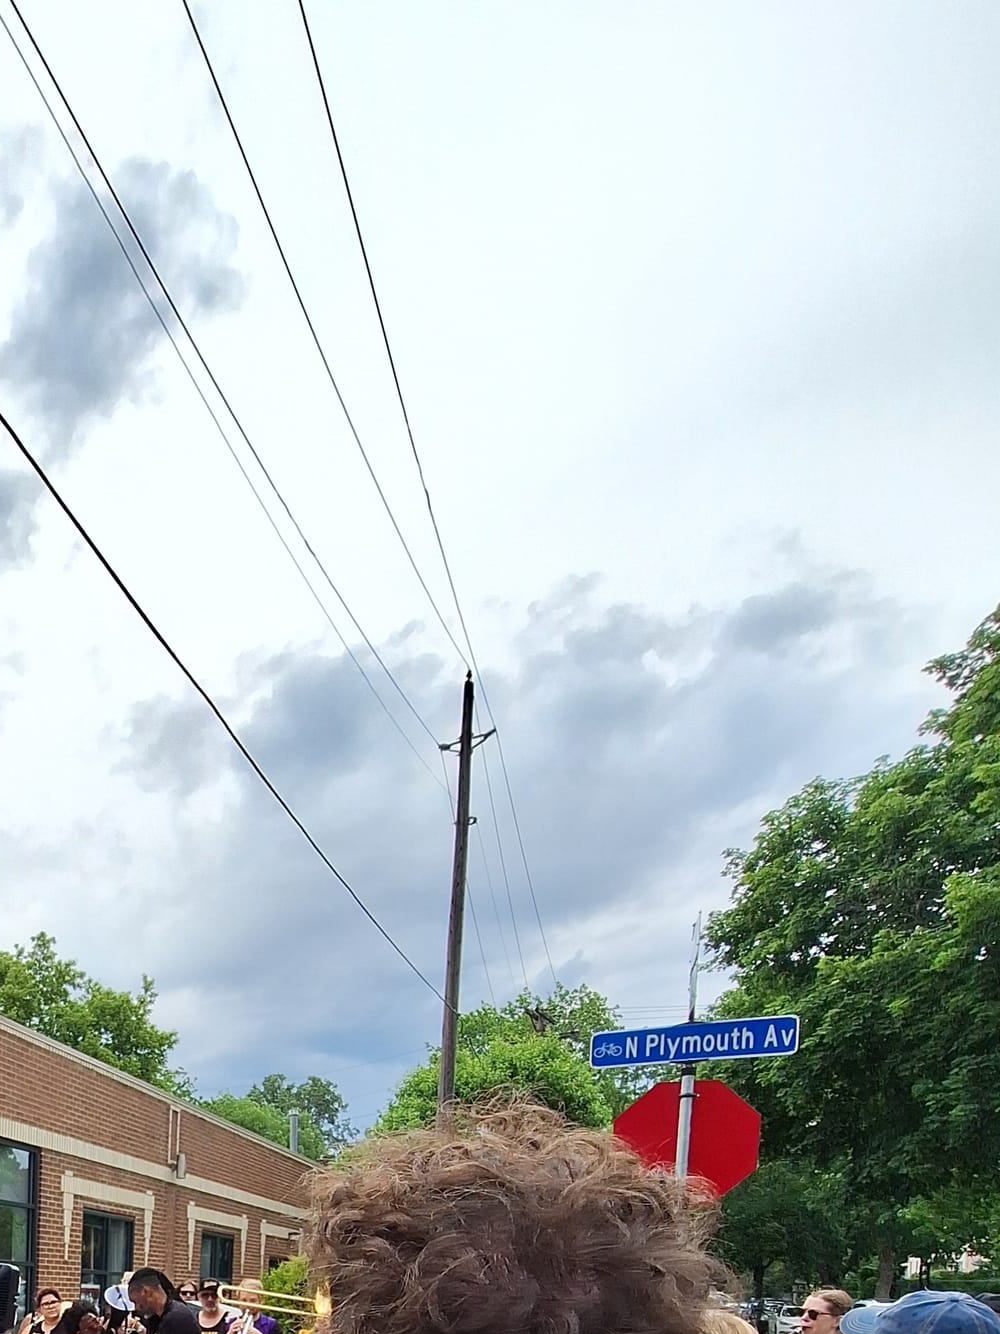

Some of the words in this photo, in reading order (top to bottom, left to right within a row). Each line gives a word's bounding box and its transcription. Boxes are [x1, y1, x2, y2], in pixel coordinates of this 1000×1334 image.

[625, 1036, 638, 1058] N
[645, 1027, 754, 1059] Plymouth
[764, 1024, 795, 1048] Av
